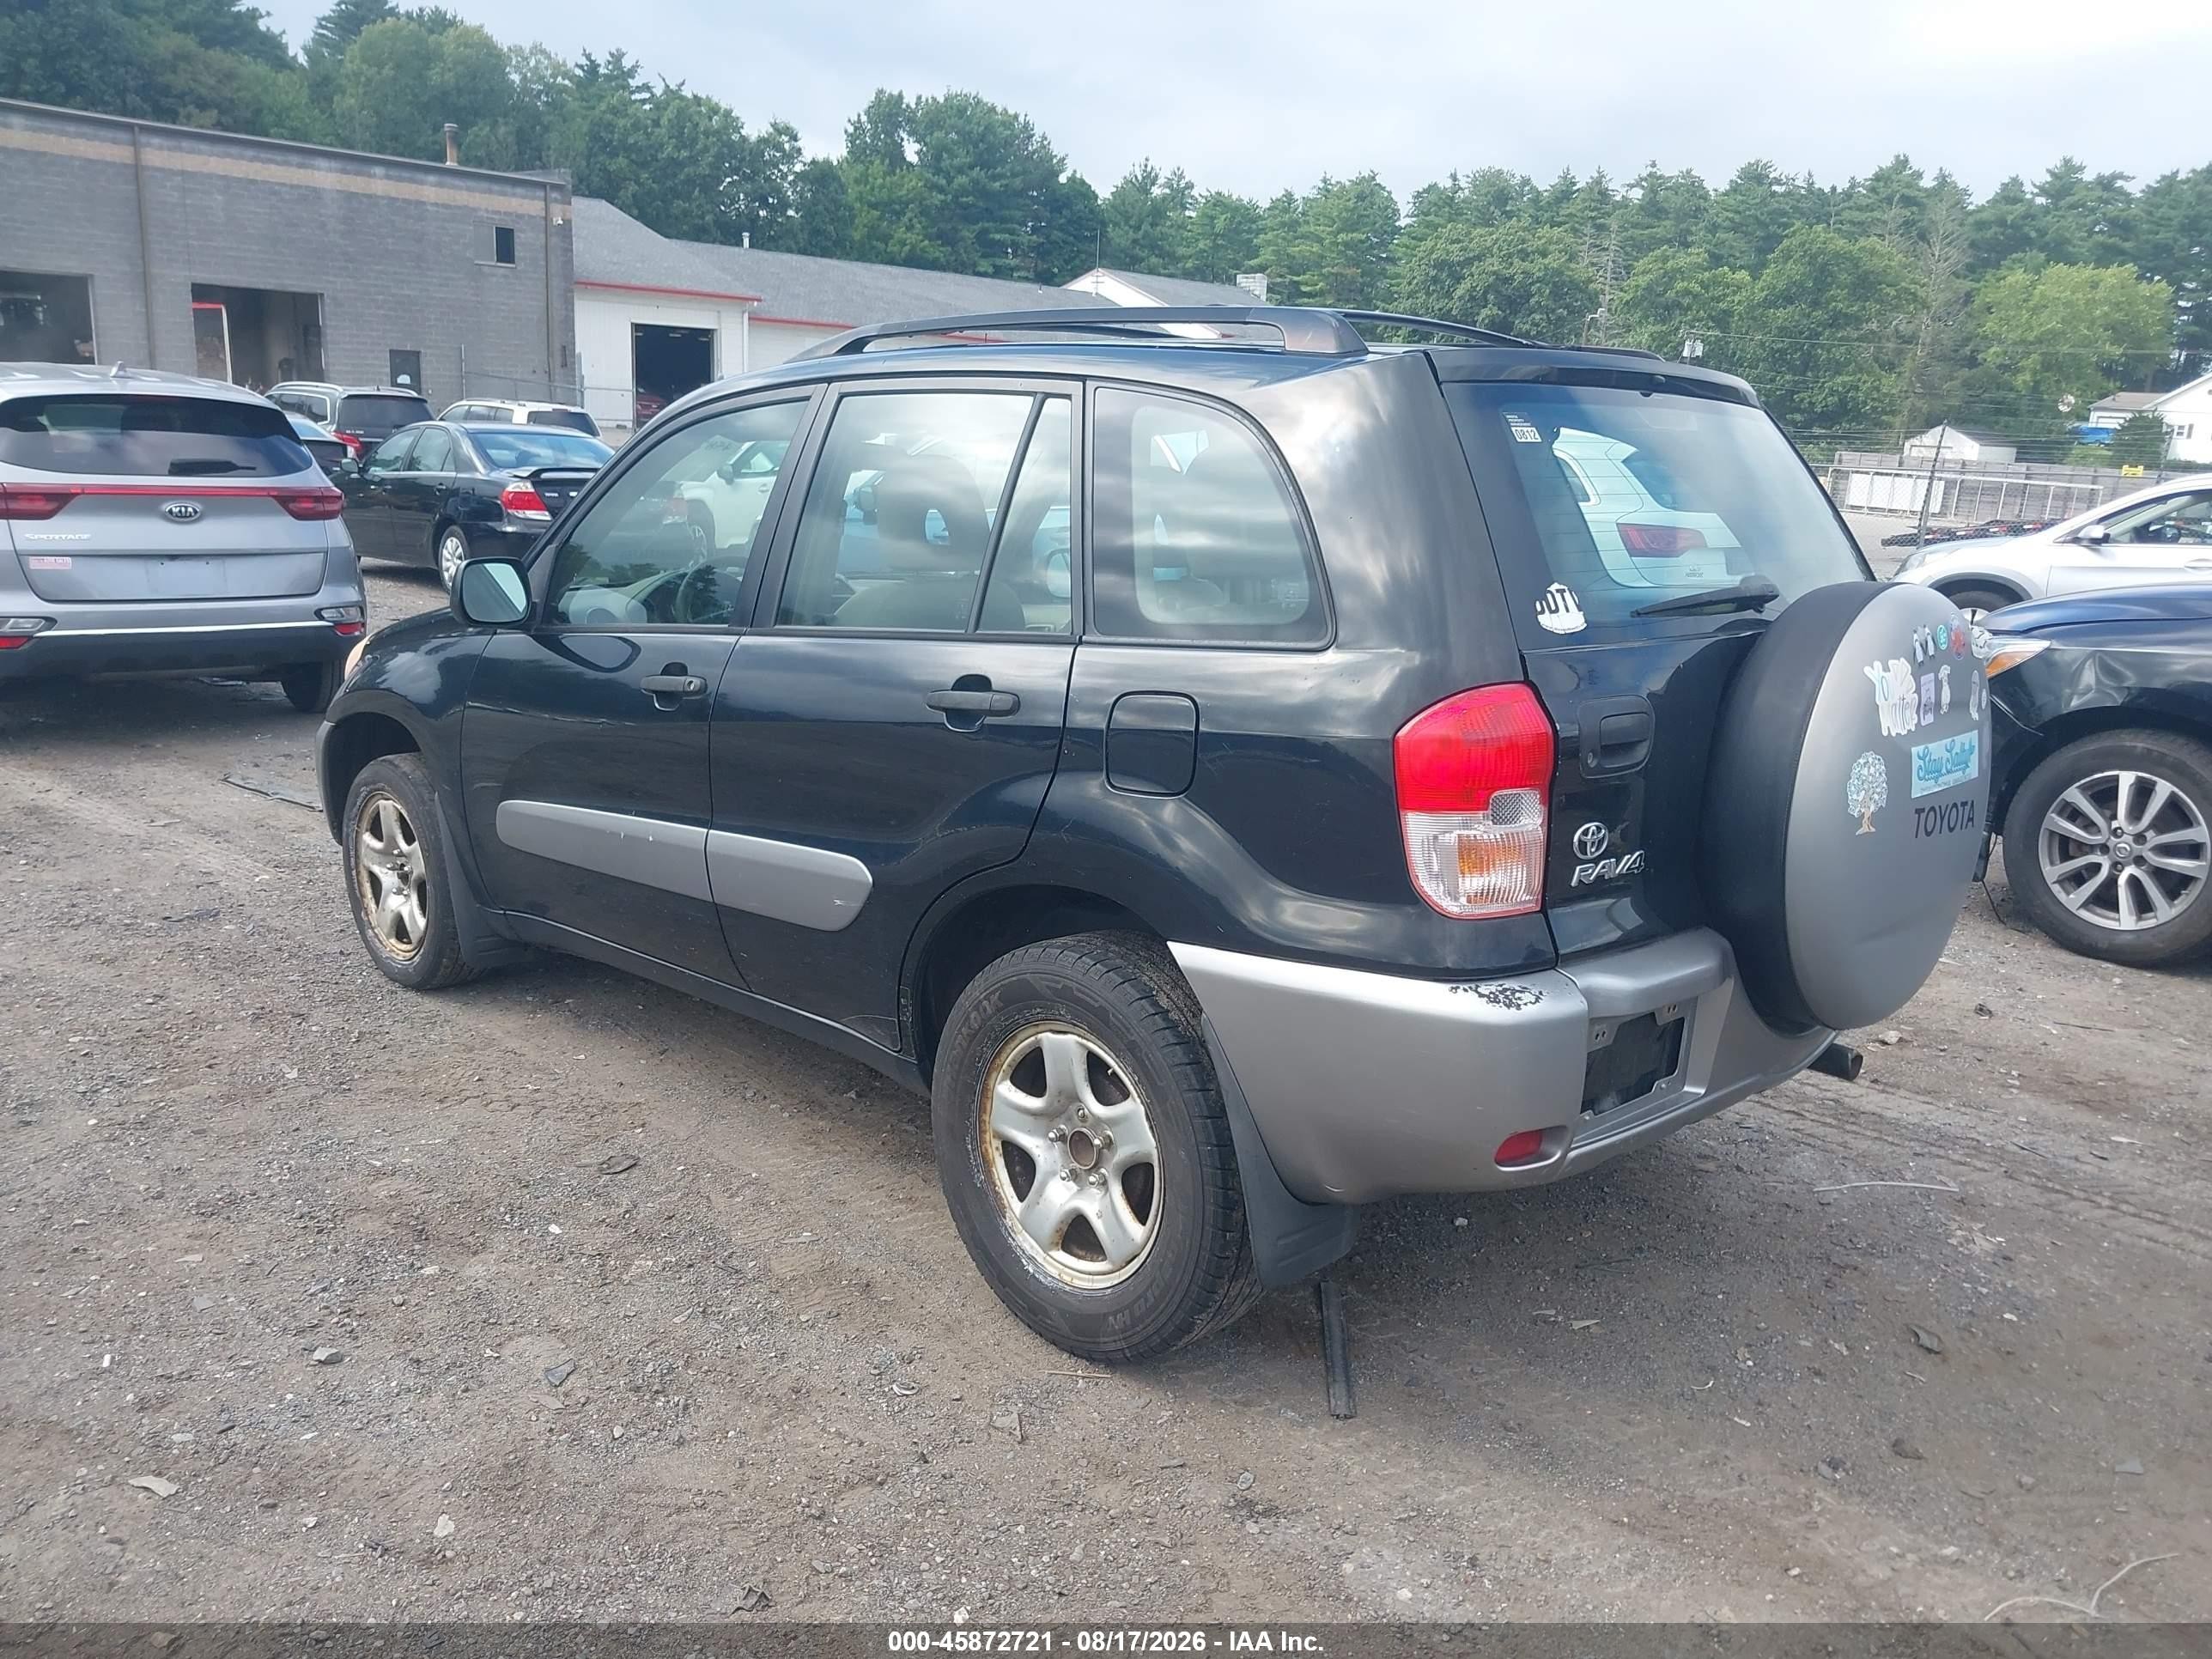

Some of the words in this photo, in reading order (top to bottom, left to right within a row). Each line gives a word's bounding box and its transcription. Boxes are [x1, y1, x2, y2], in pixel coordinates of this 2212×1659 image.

[171, 506, 195, 517] KIA
[1914, 799, 1975, 839] TOYOTA
[1571, 850, 1645, 887] RAV4
